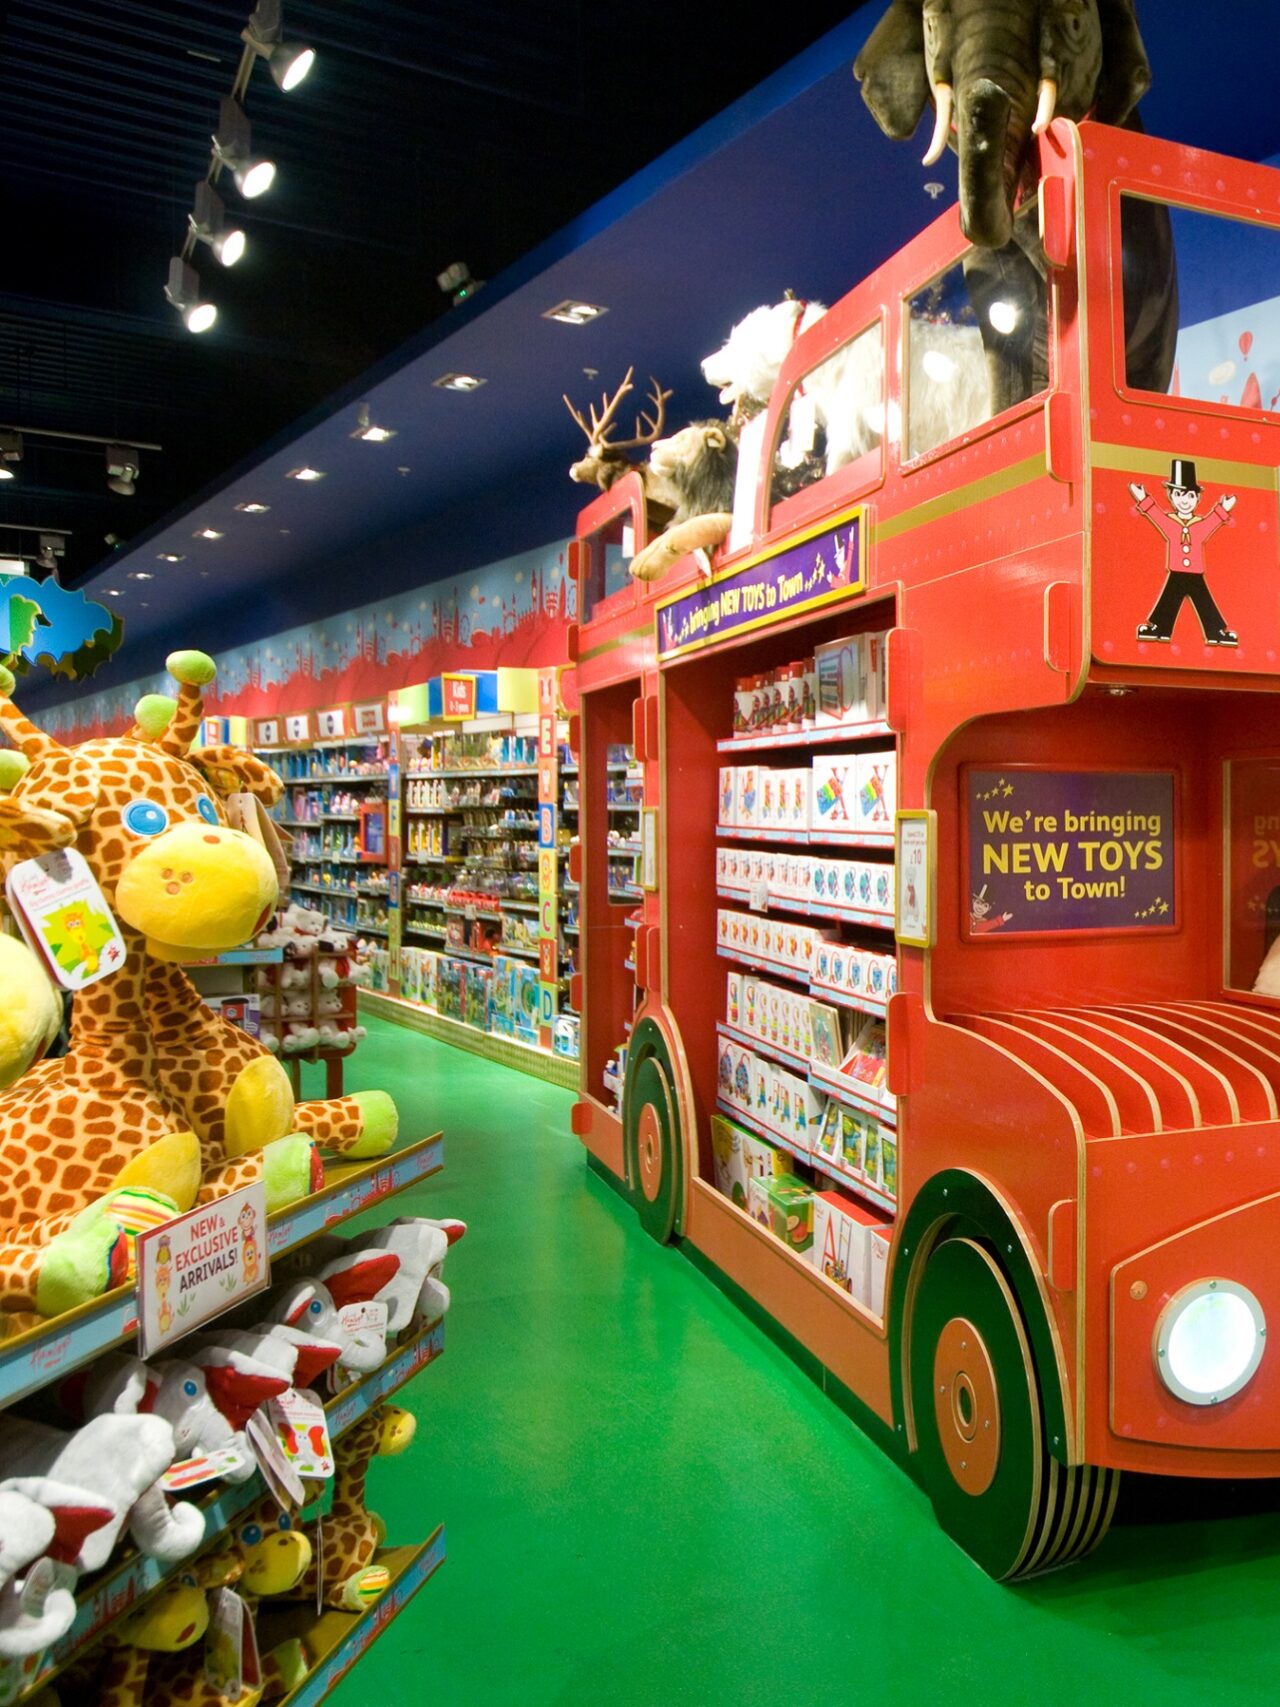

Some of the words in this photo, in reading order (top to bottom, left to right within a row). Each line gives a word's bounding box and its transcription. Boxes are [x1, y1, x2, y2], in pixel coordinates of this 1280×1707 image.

[689, 600, 720, 634] bringing
[720, 586, 739, 617] NEW
[742, 582, 765, 612] TOYS
[765, 584, 776, 607] to
[777, 572, 803, 602] Town
[541, 807, 552, 844] B
[983, 810, 1058, 834] We're
[1064, 810, 1161, 837] bringing
[983, 842, 1069, 874] NEW
[1078, 841, 1163, 871] TOYS
[1024, 880, 1050, 901] to
[1057, 876, 1125, 900] Town!
[543, 901, 551, 931] C
[544, 989, 552, 1020] D
[190, 1214, 218, 1242] NEW
[219, 1217, 225, 1228] &
[175, 1226, 239, 1273] EXCLUSIVE
[179, 1248, 239, 1294] ARRIVALS!
